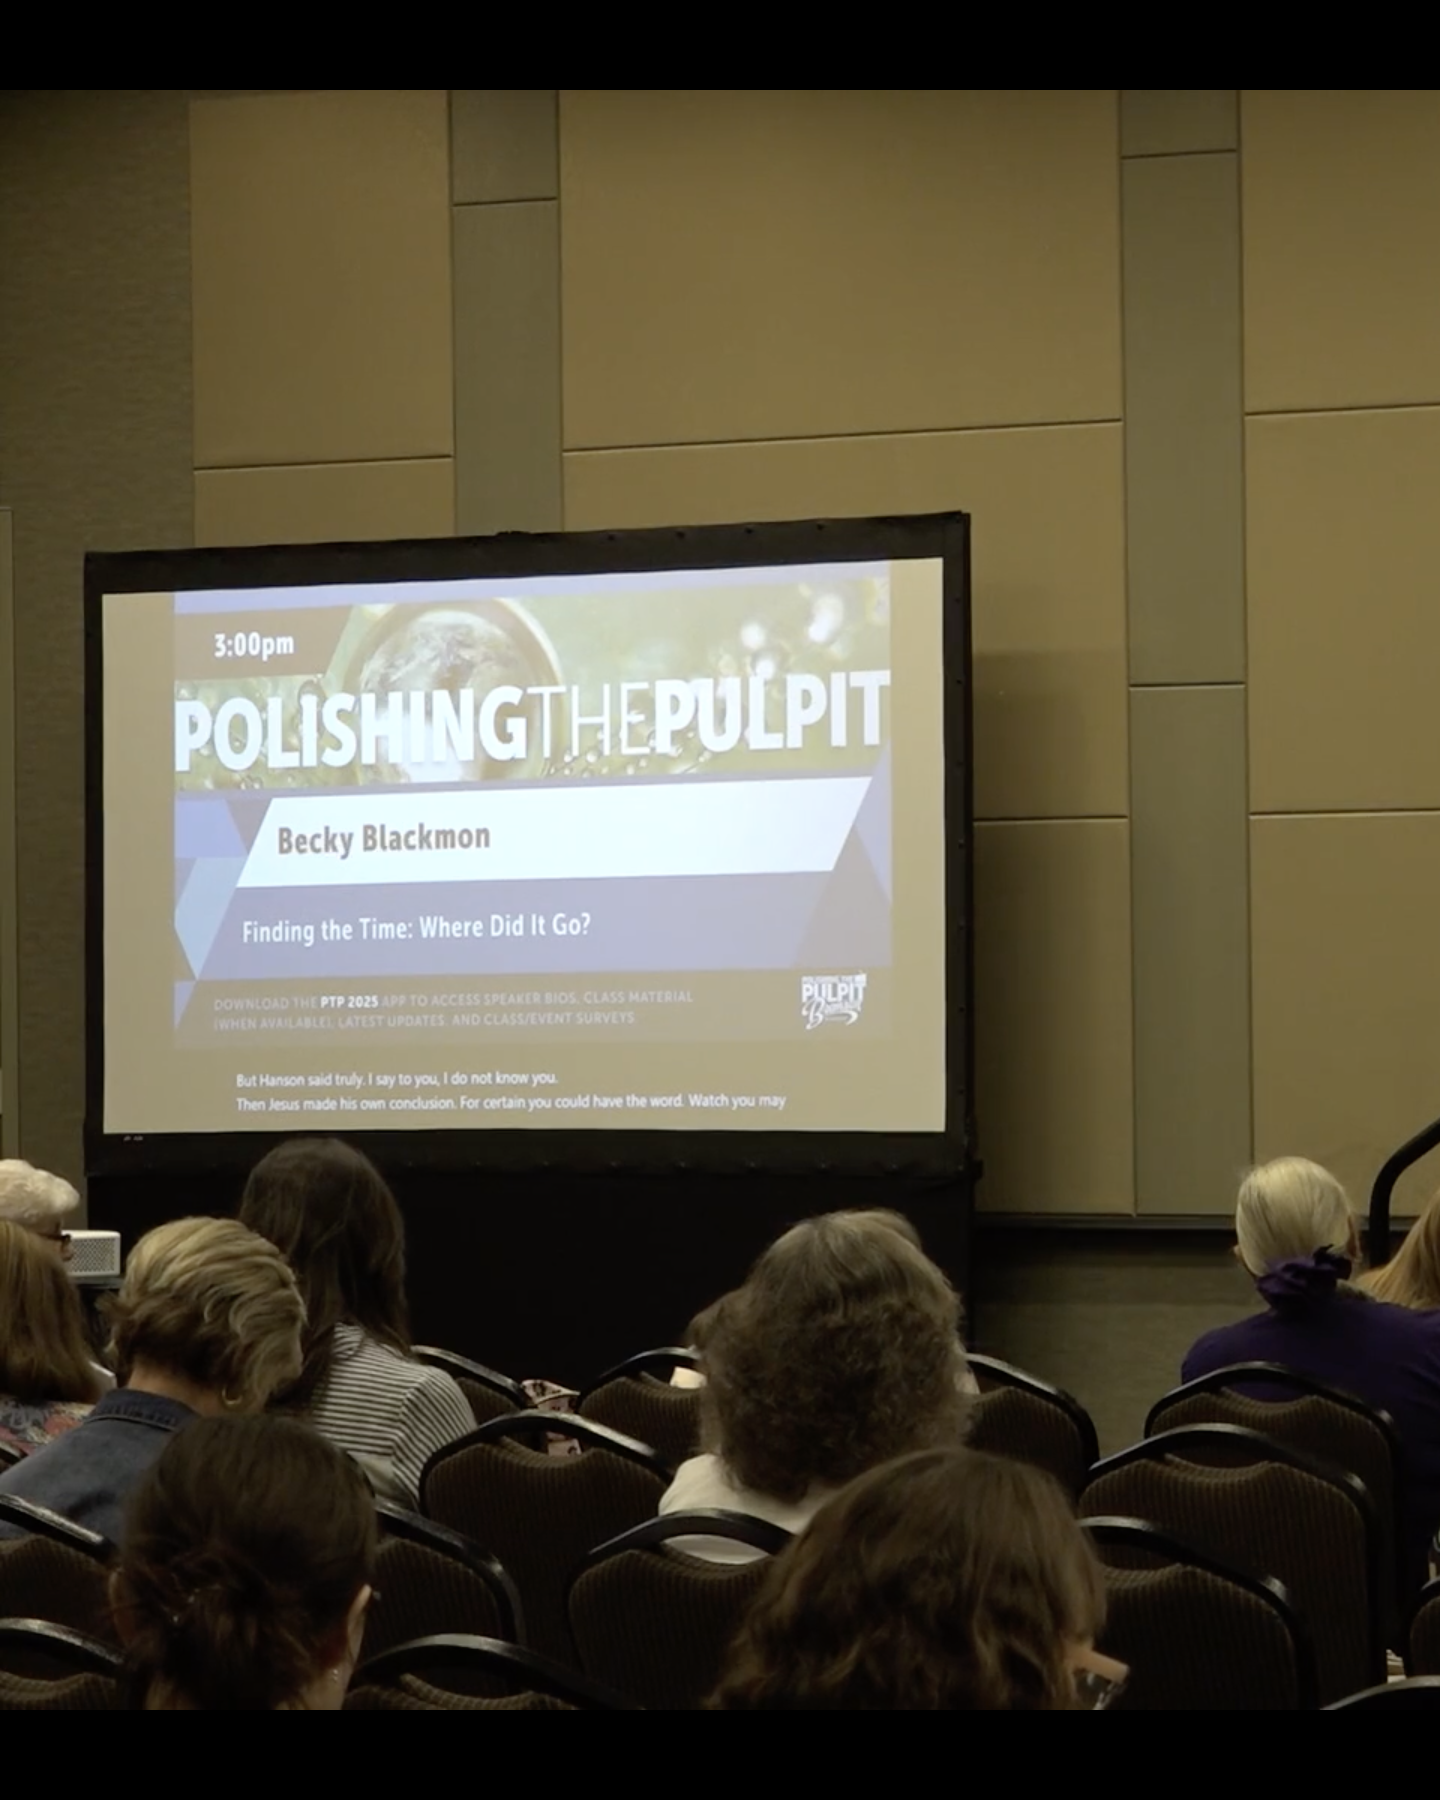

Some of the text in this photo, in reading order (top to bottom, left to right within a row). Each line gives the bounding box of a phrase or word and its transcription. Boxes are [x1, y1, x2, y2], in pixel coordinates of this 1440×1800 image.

[213, 631, 296, 662] 3:00pm
[278, 822, 491, 860] Becky Blackmon
[243, 911, 591, 948] Finding the Time: Where Did It Go?
[214, 998, 289, 1011] DOWNLOAD
[293, 996, 318, 1009] THE
[320, 995, 345, 1008] PTP
[347, 995, 379, 1008] 2025
[382, 995, 405, 1008] APP
[410, 994, 428, 1008] TO
[431, 993, 480, 1007] ACCESS
[483, 992, 540, 1006] SPEAKER
[583, 991, 625, 1004] CLASS
[628, 990, 694, 1003] MATERIAL
[801, 983, 864, 1003] PULPIT
[338, 1015, 384, 1028] LATEST
[452, 1013, 481, 1026] AND
[483, 1012, 572, 1025] CLASS/EVENT
[575, 1011, 636, 1024] SURVEYS
[236, 1071, 559, 1089] But Hanson said truly. I say to you, I do not know you.
[236, 1093, 787, 1112] Then Jesus made his own conclusion. For certain you could have the word. Watch you may
